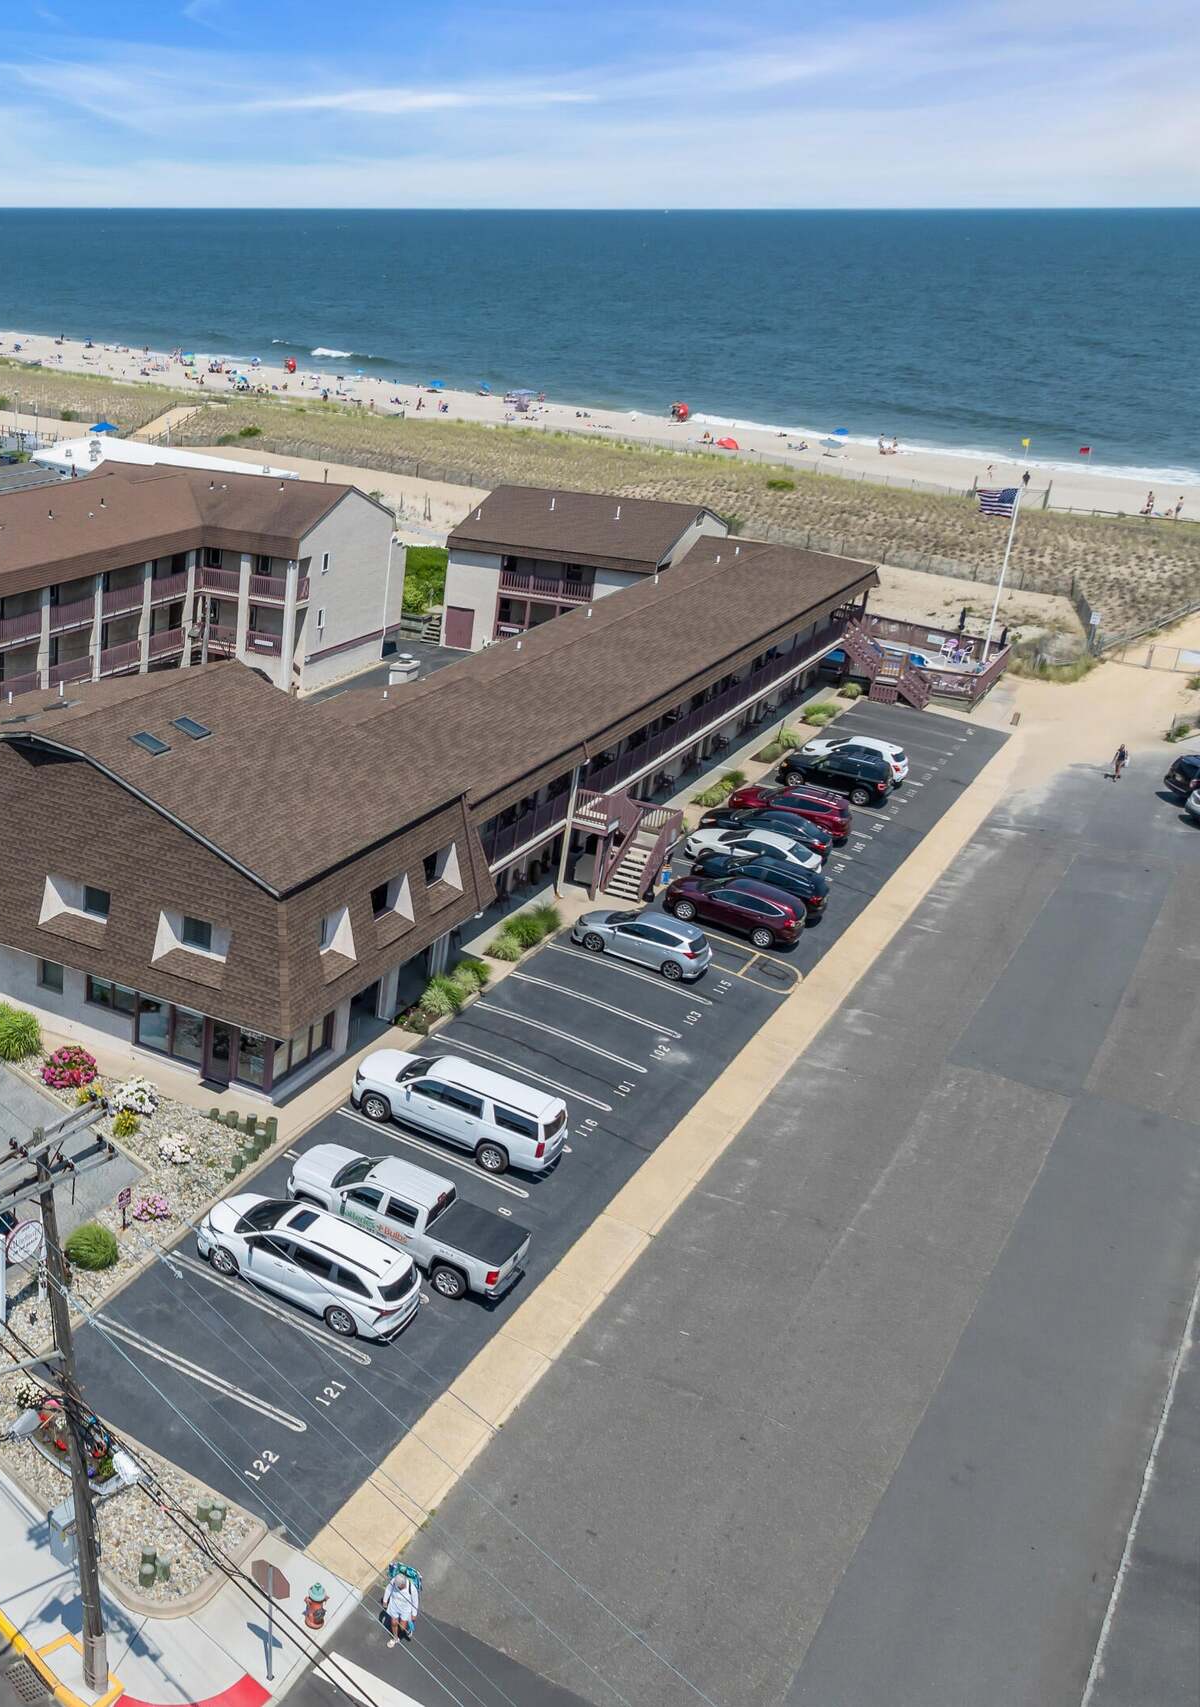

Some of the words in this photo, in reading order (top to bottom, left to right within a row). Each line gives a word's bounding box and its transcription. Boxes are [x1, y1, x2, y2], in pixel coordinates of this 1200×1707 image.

[712, 980, 732, 994] 115
[682, 1010, 702, 1026] 103
[648, 1044, 671, 1061] 102
[613, 1080, 636, 1097] 101
[574, 1118, 599, 1137] 116
[315, 1380, 347, 1406] 121
[244, 1450, 280, 1481] 122
